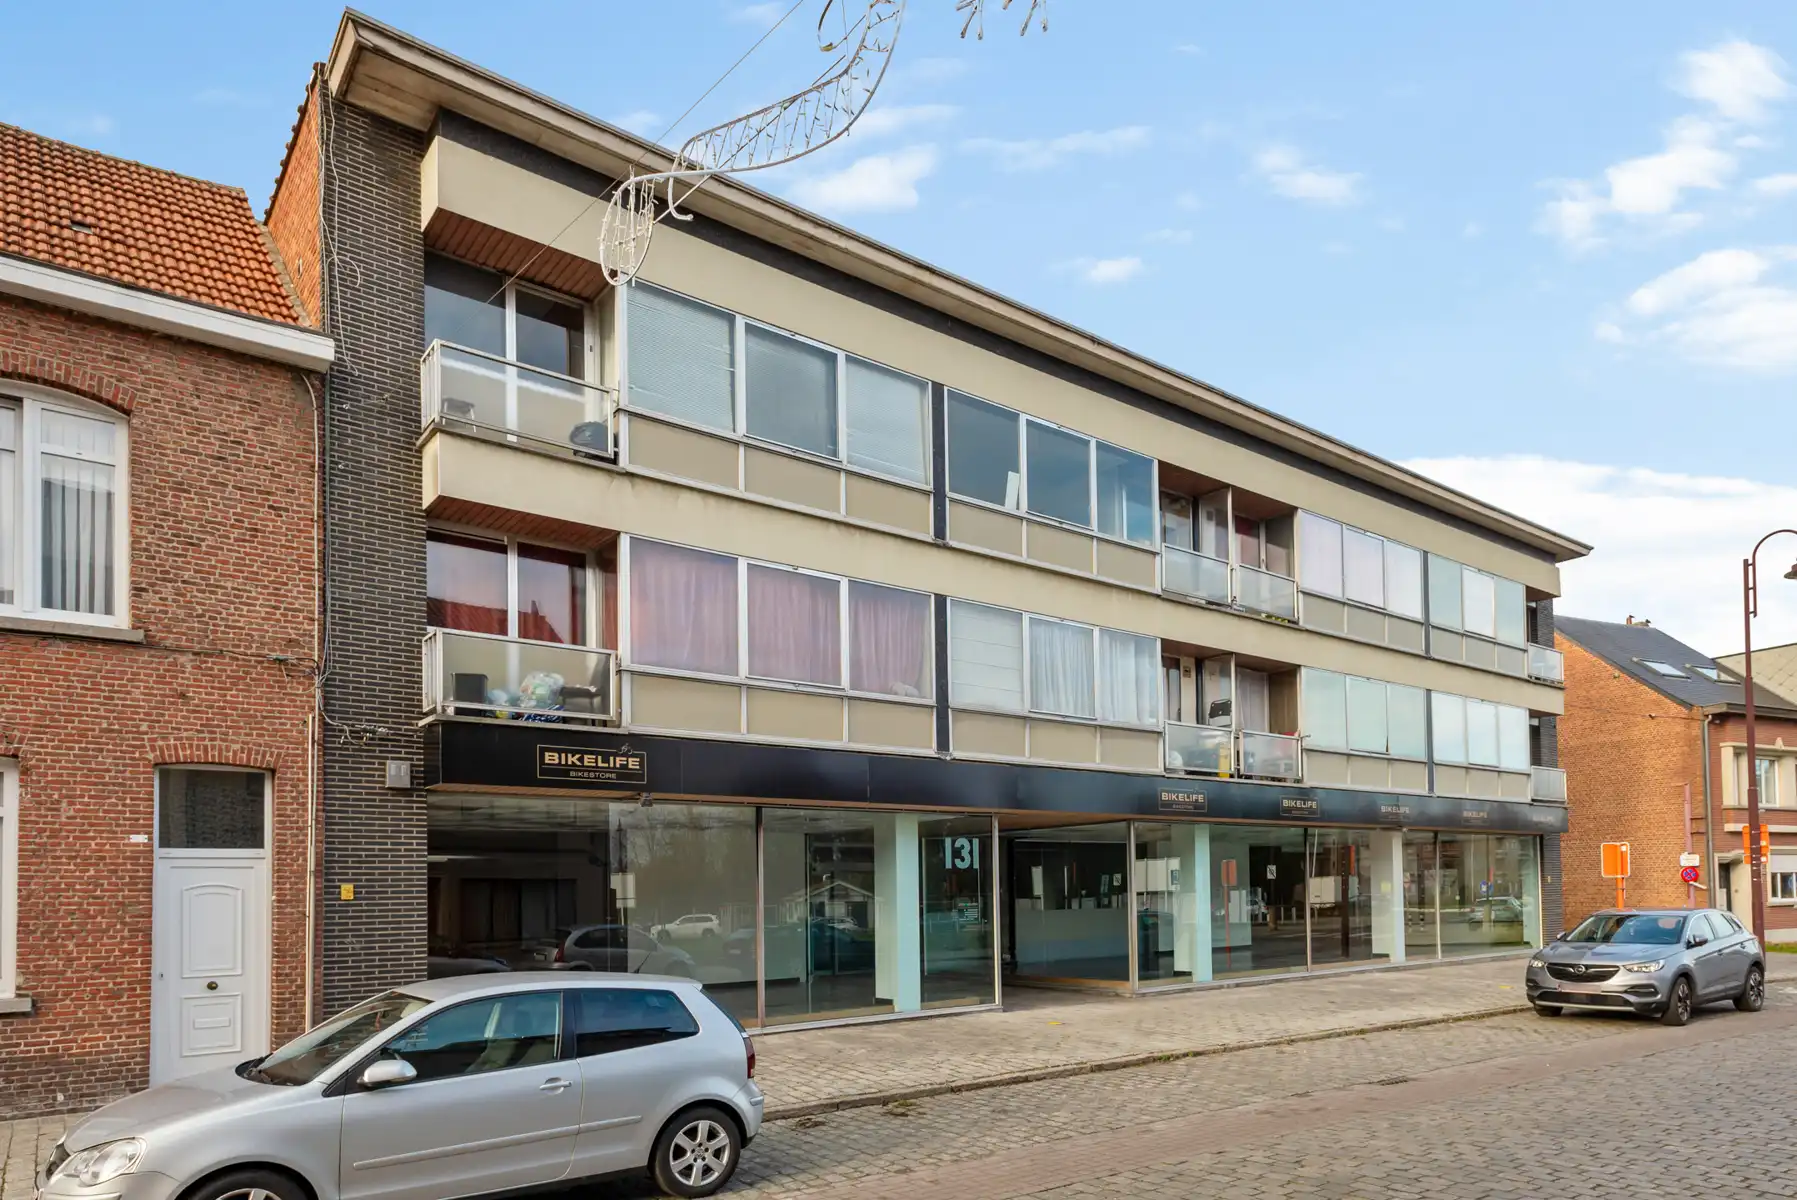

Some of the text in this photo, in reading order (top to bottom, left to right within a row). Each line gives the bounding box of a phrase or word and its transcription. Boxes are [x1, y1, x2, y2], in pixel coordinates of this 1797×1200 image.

[544, 751, 640, 769] BIKELIFE
[569, 770, 617, 779] BIKESTORE
[1161, 792, 1205, 803] BIKELIFE
[1282, 799, 1317, 809] BIKELIFE
[945, 837, 979, 869] 131
